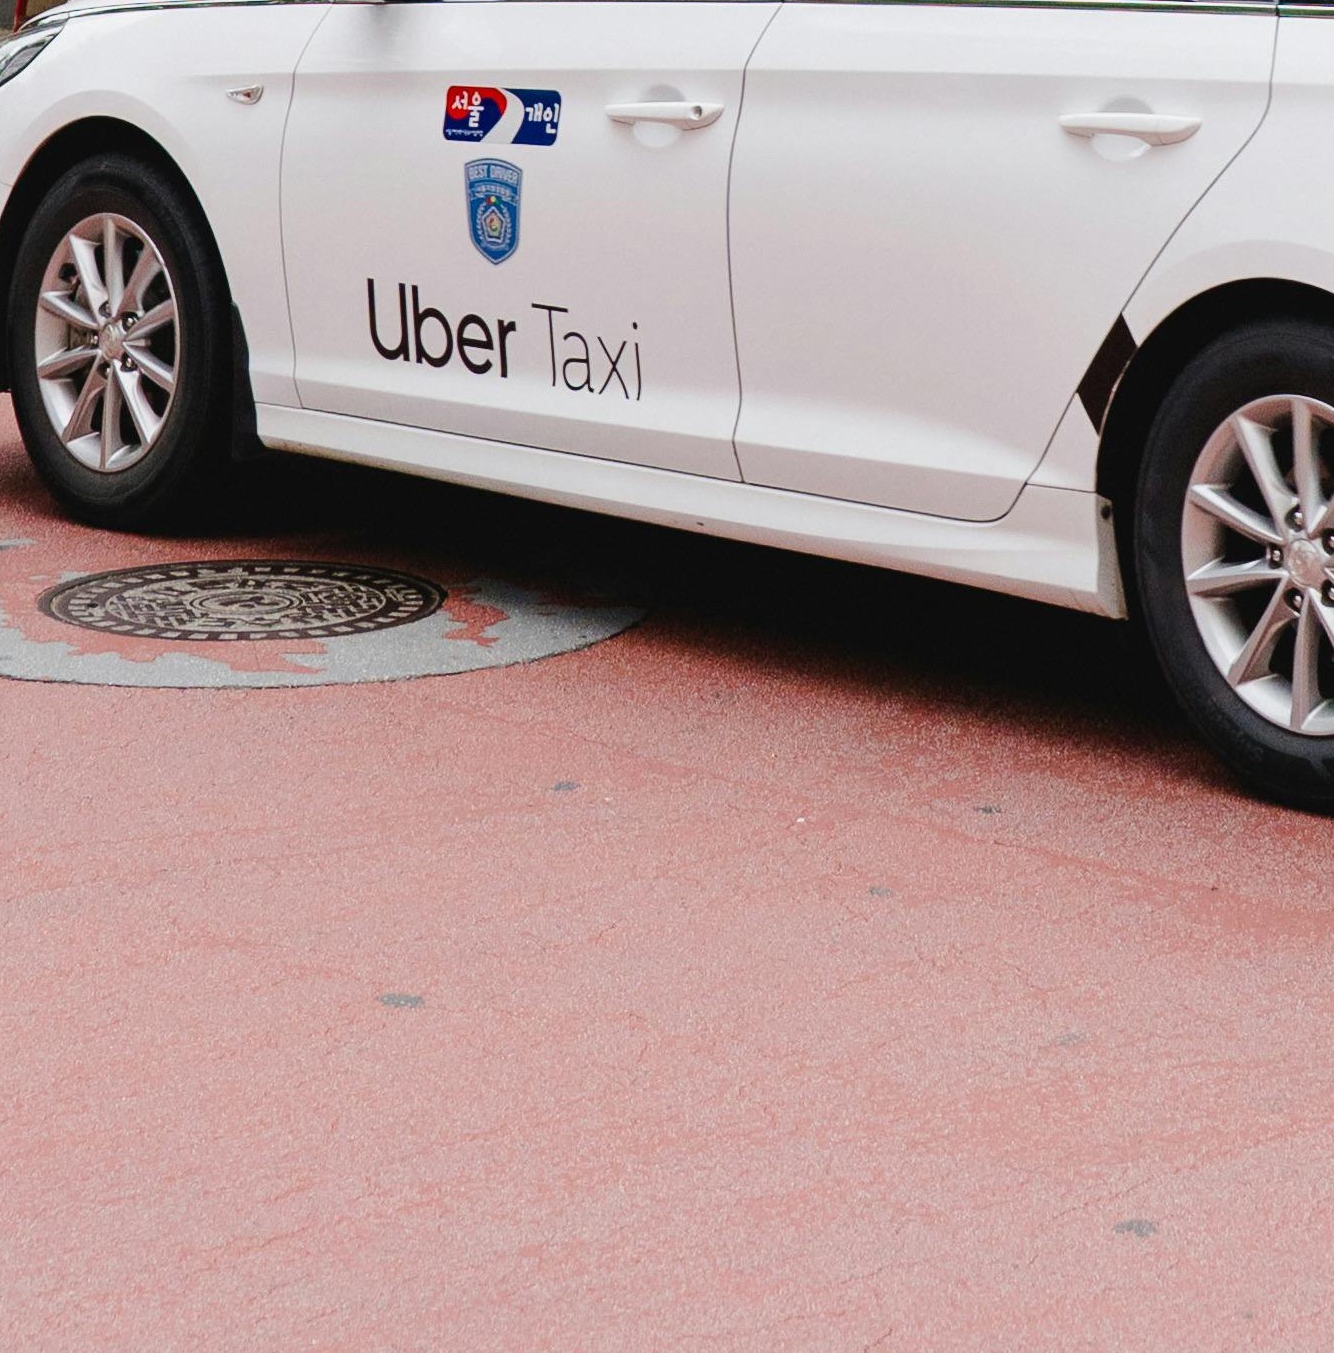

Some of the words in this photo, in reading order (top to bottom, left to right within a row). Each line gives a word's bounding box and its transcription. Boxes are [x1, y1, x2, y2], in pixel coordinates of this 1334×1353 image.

[452, 91, 485, 127] 서울
[526, 103, 560, 134] 개인
[367, 278, 517, 378] Uber
[531, 303, 641, 401] Taxi
